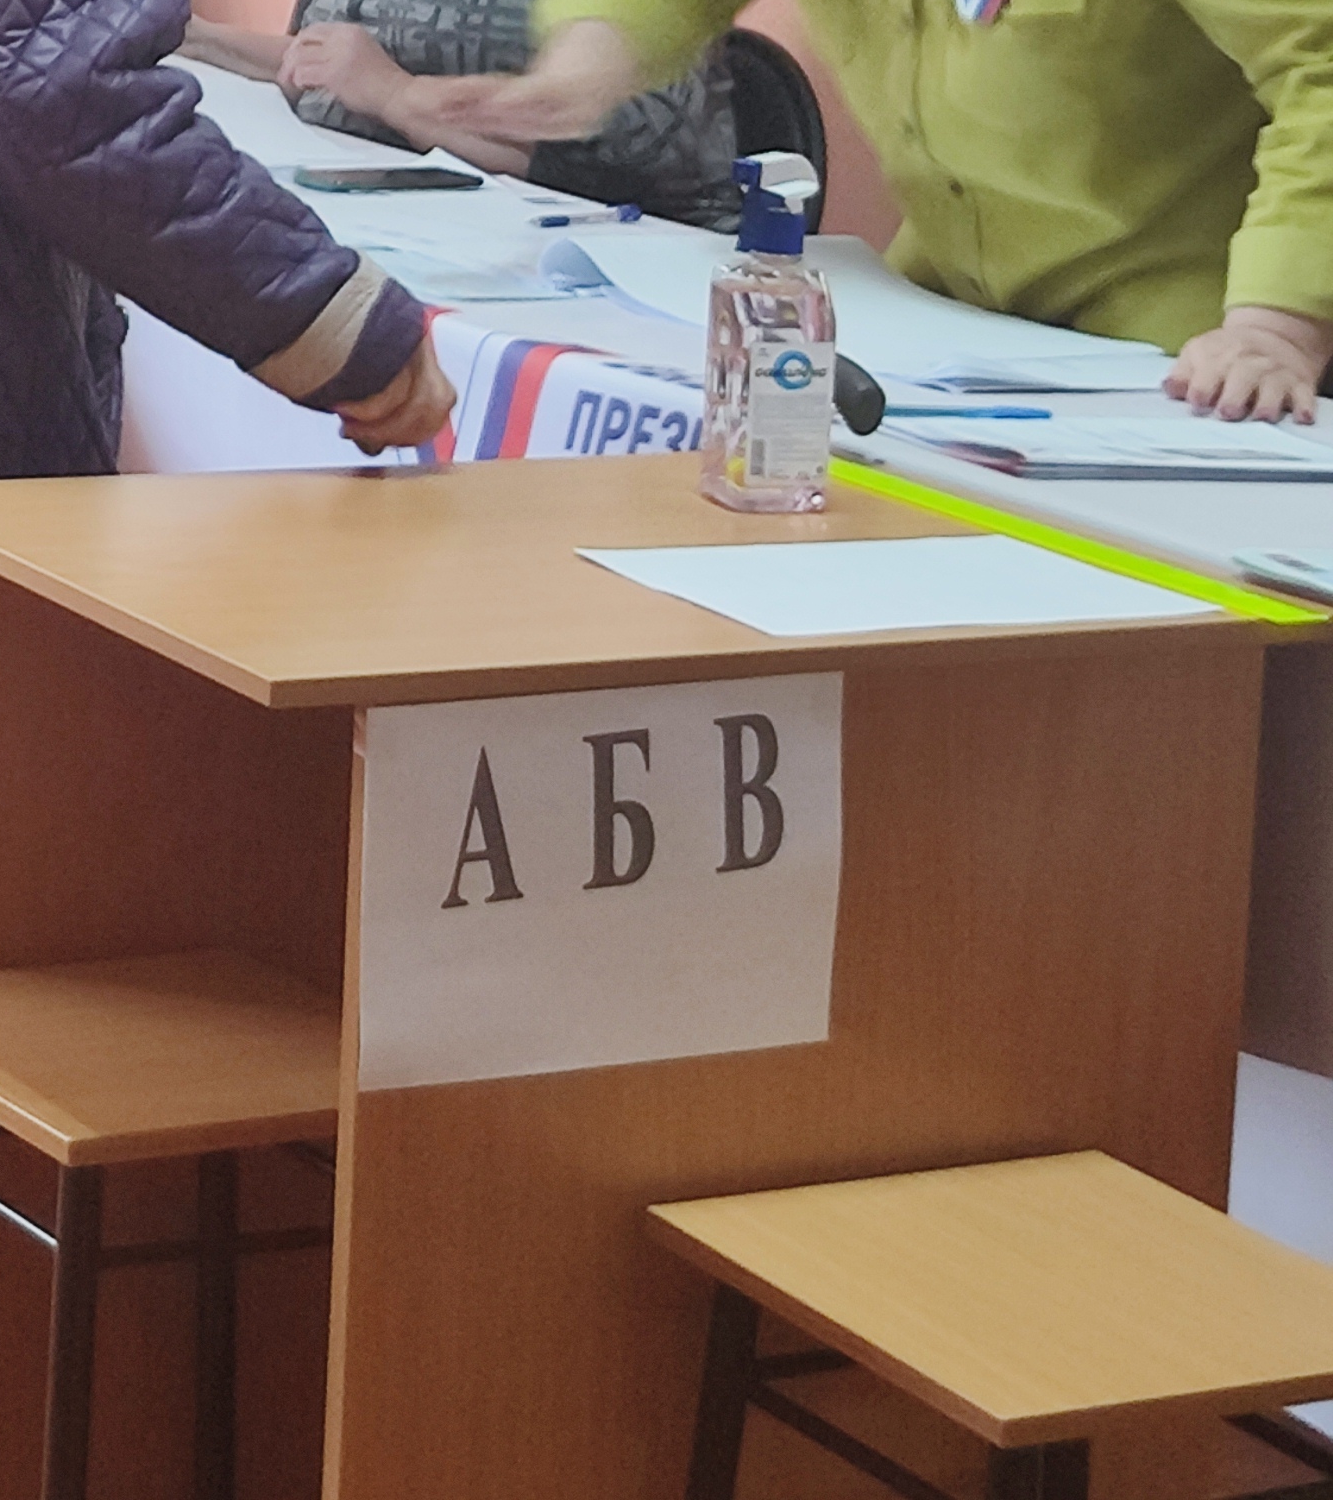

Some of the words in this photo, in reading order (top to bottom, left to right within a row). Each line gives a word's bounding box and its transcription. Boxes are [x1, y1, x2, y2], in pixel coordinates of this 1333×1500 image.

[441, 745, 524, 909] А
[582, 728, 655, 890] Б
[713, 713, 784, 874] В
